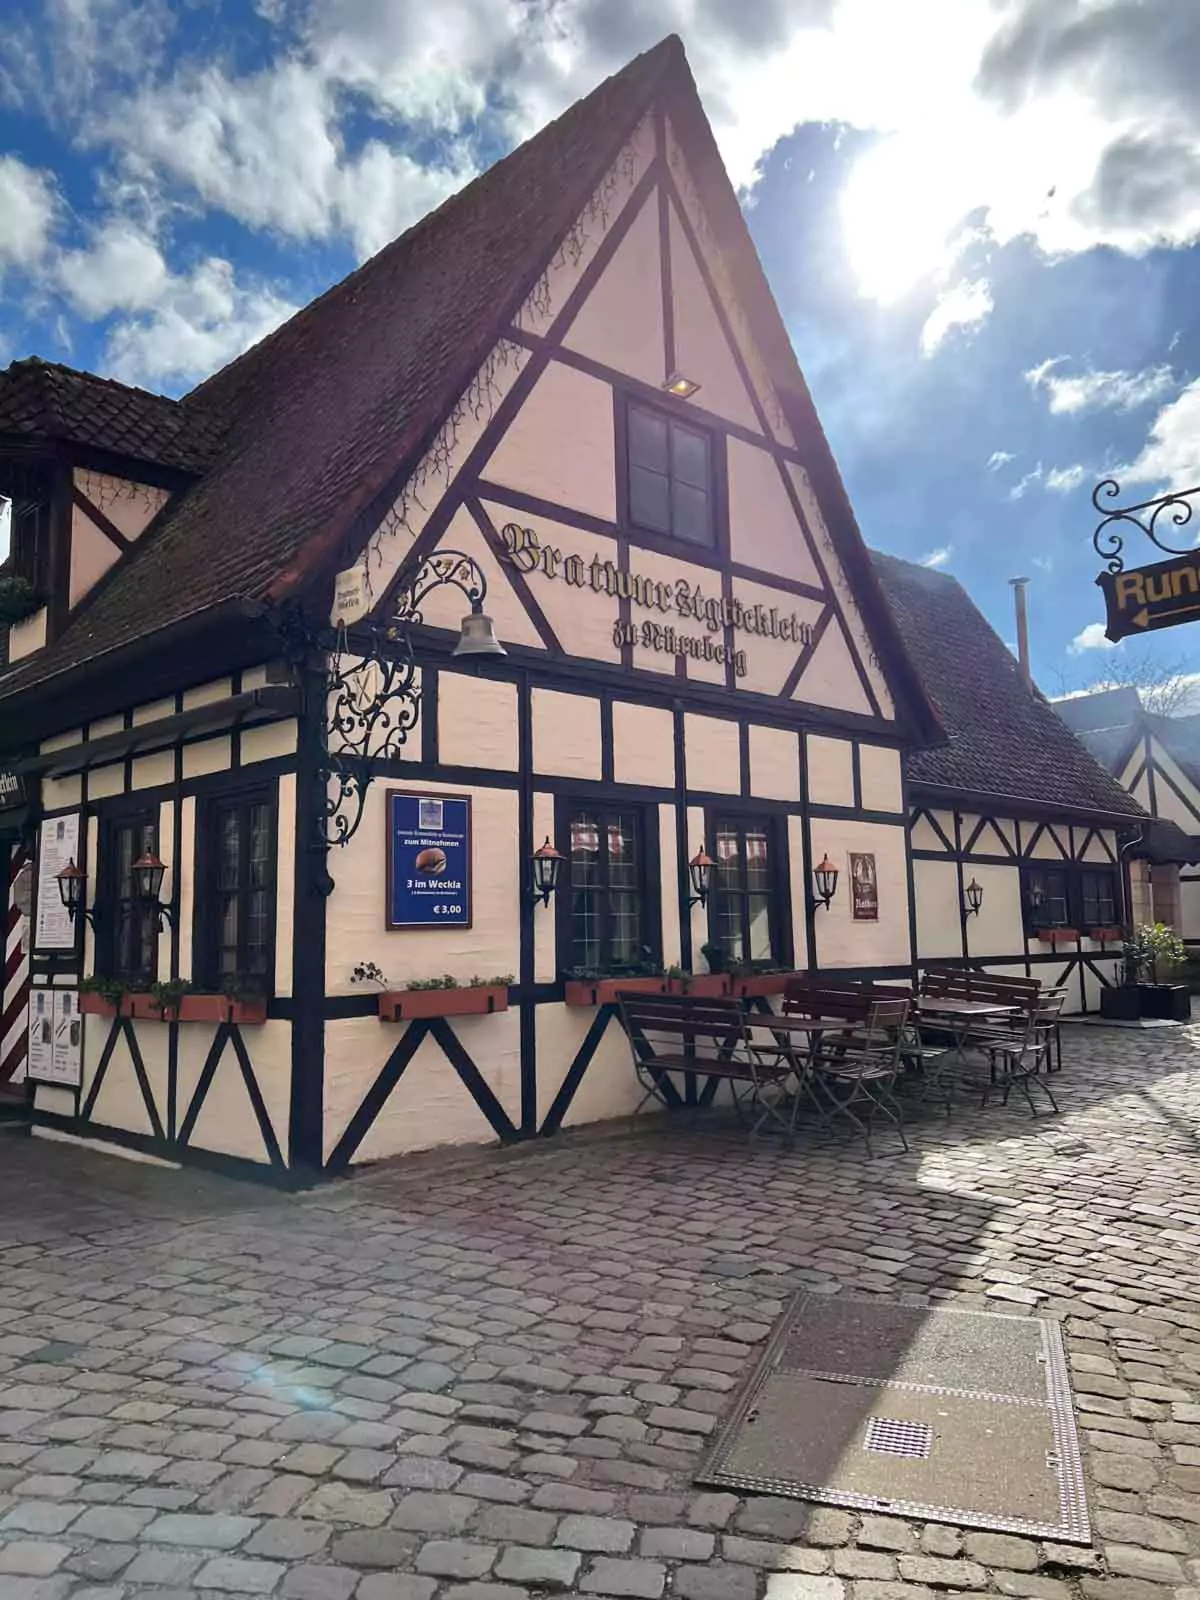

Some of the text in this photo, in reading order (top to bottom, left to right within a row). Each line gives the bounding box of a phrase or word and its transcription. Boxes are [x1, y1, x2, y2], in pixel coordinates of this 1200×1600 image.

[1116, 566, 1200, 610] Run
[641, 620, 748, 678] Nürnberg
[420, 839, 460, 847] Mitnehmen
[407, 879, 462, 889] 3 im Weckla
[441, 904, 462, 915] 3,00
